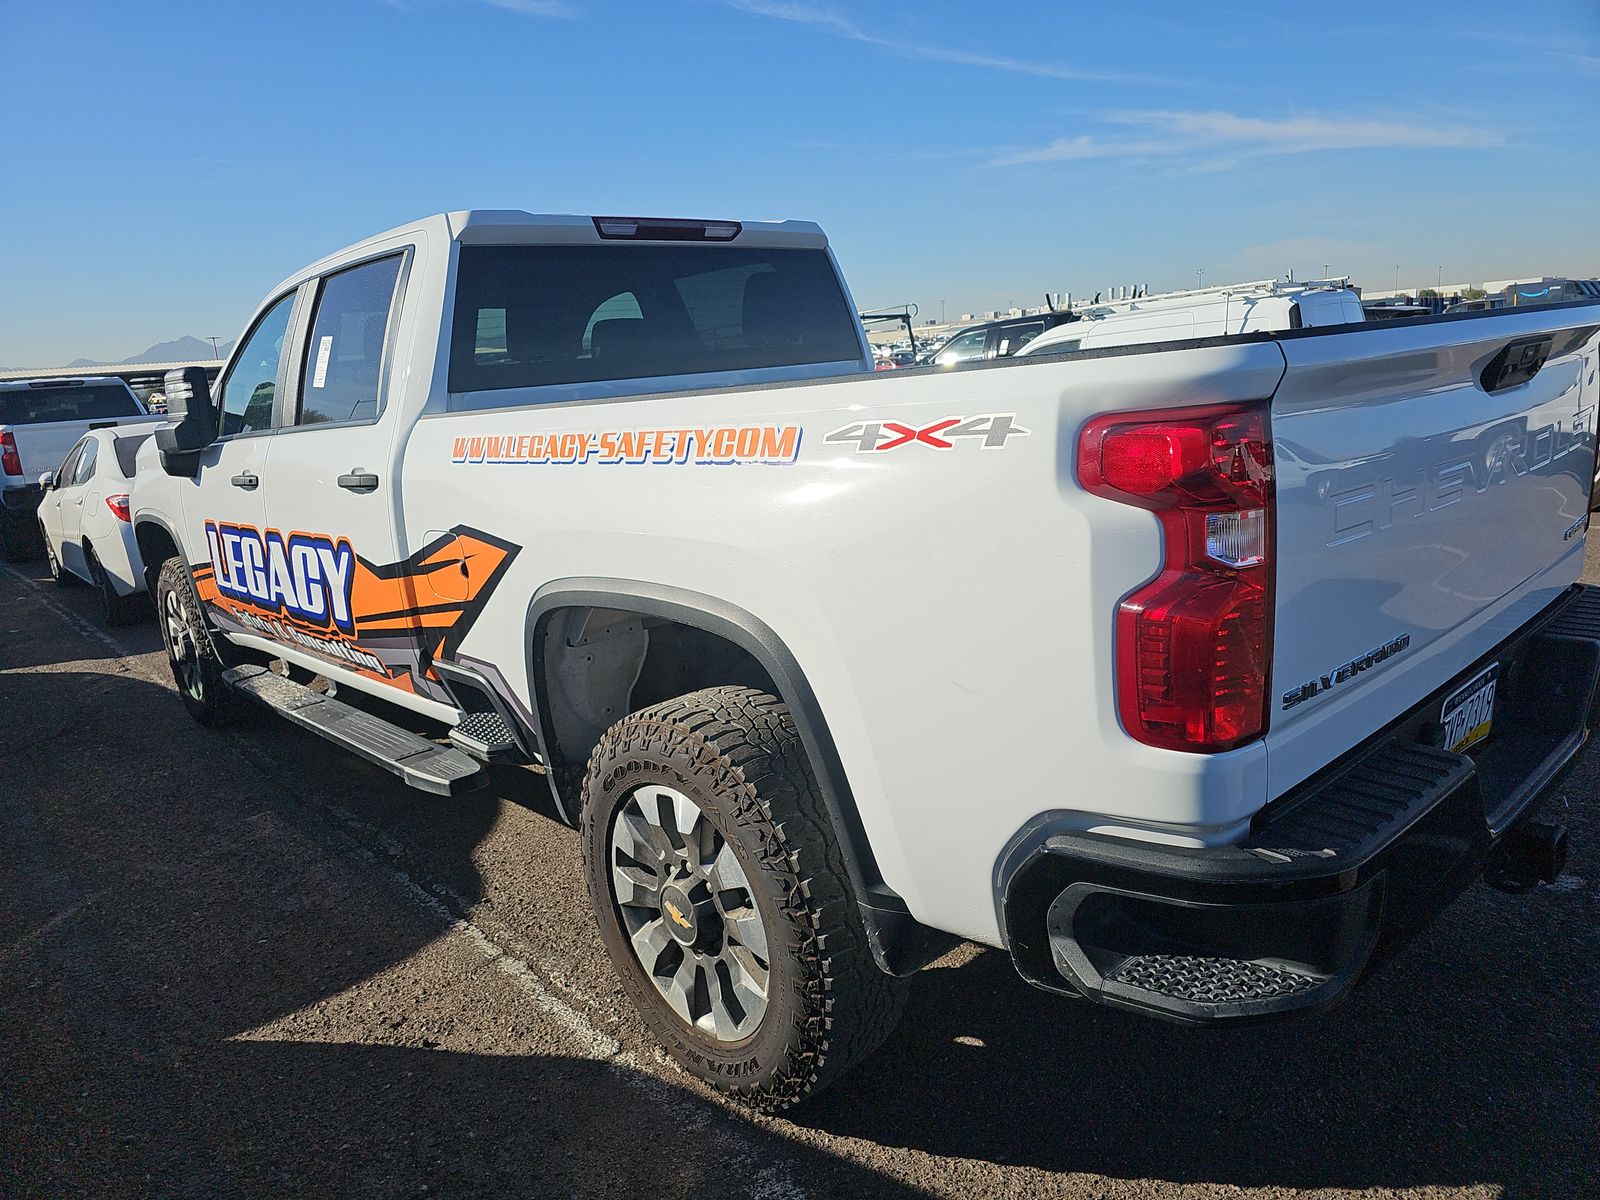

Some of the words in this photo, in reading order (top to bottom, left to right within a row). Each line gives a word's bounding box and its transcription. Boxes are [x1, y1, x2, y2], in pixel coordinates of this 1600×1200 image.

[451, 426, 803, 465] WWW.LEGACY-SAFETY.COM
[824, 415, 1030, 452] 4X4
[1326, 404, 1595, 548] CHEVROLET
[206, 525, 354, 631] LEGACY
[287, 625, 386, 674] Consulting
[1282, 633, 1410, 710] SILVERADO
